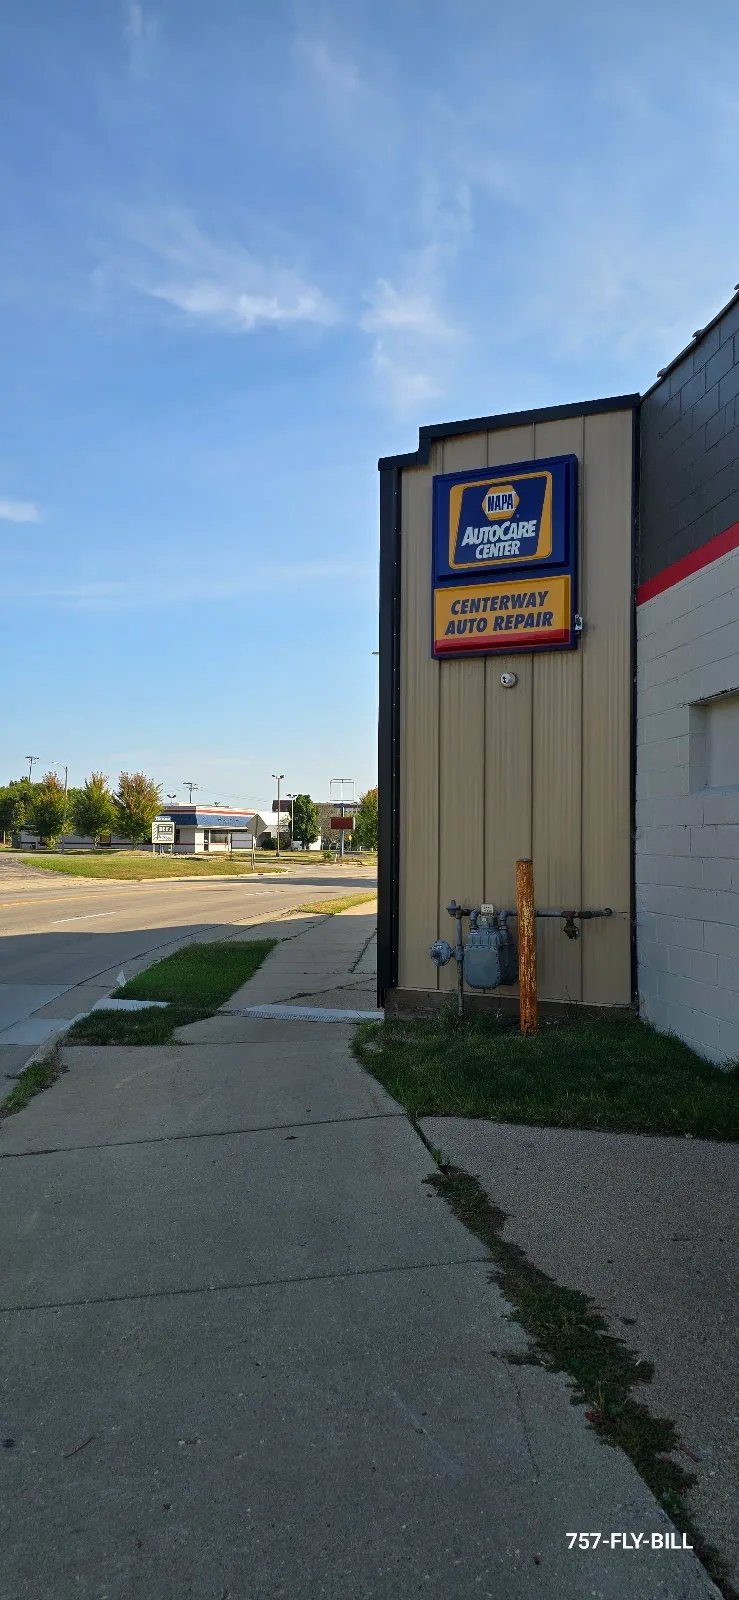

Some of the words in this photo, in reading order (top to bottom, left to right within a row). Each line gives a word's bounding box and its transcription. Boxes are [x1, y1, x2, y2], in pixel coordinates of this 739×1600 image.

[487, 493, 514, 512] NAPA
[475, 540, 521, 559] CENTER
[450, 590, 549, 616] CENTERWAY
[444, 615, 488, 636] AUTO
[492, 611, 554, 631] REPAIR
